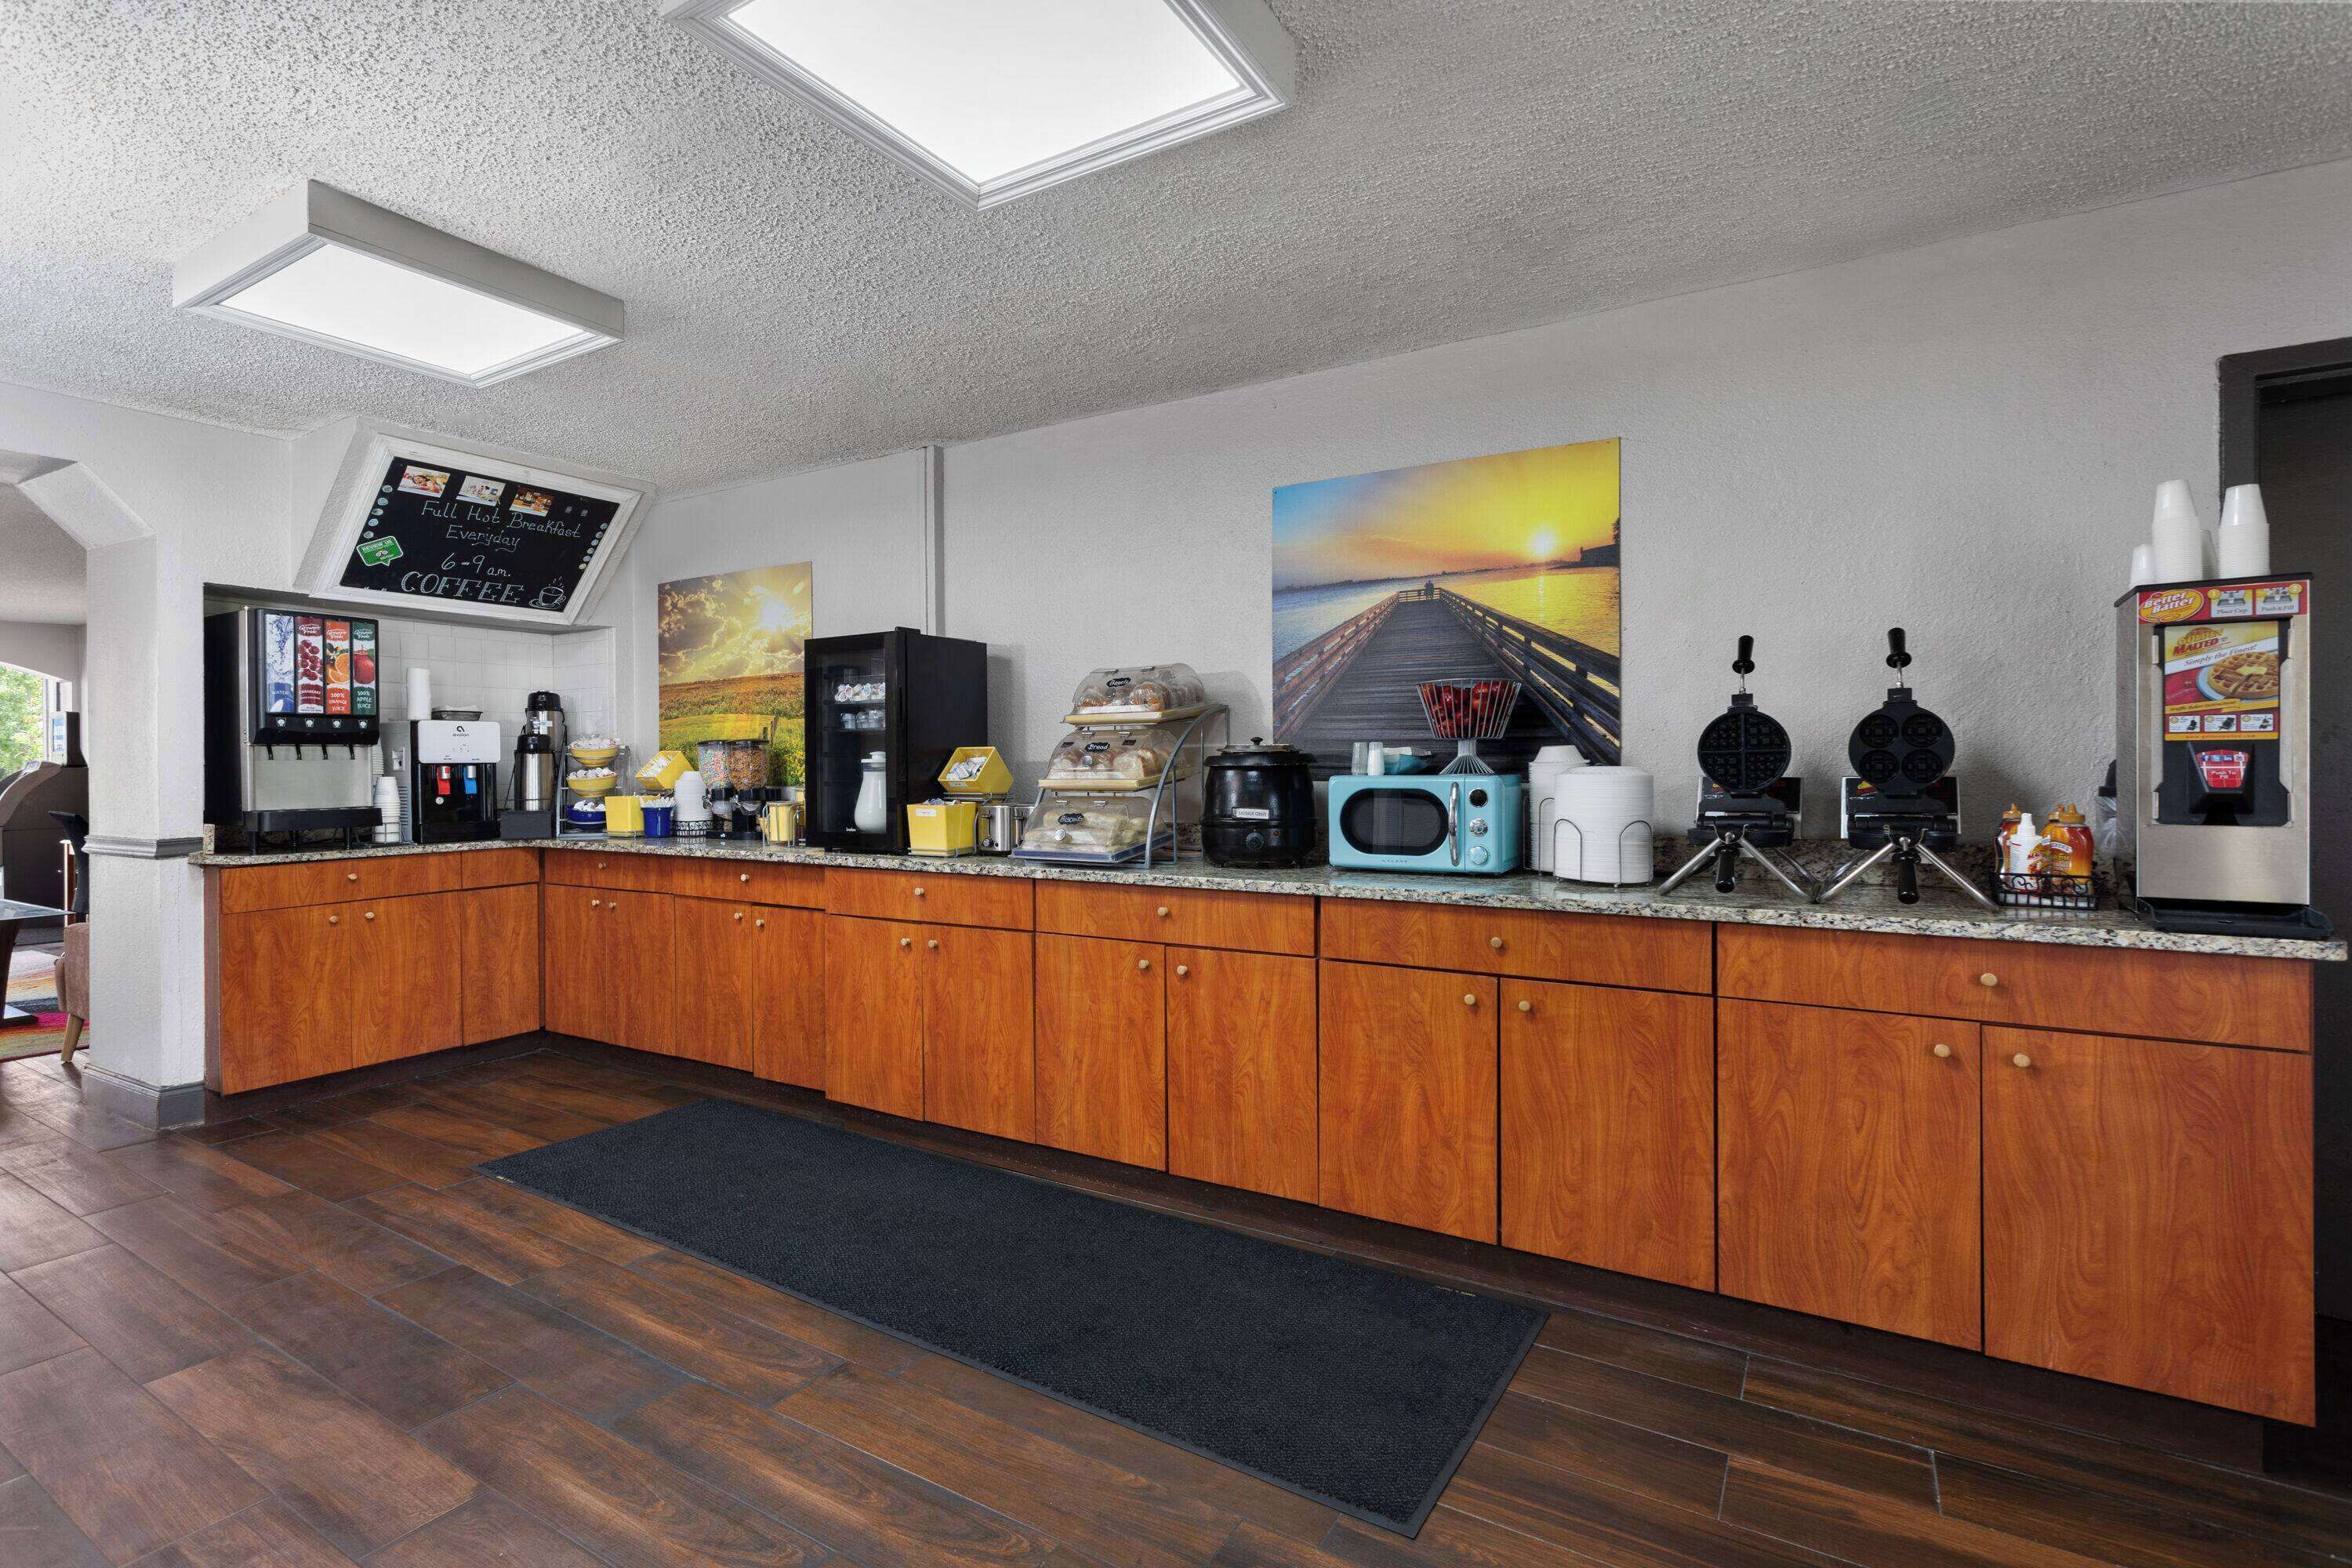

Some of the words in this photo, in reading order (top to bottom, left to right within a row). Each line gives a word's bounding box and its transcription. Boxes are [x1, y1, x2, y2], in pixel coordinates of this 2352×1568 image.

[421, 500, 457, 519] Full
[466, 505, 500, 524] Hot
[506, 511, 581, 539] Breakfast
[445, 524, 521, 552] Everyday
[401, 571, 524, 603] COFFEE
[2143, 591, 2188, 609] Better
[2152, 597, 2196, 614] Batter
[2172, 637, 2220, 655] MALTED
[2183, 655, 2212, 666] Simply
